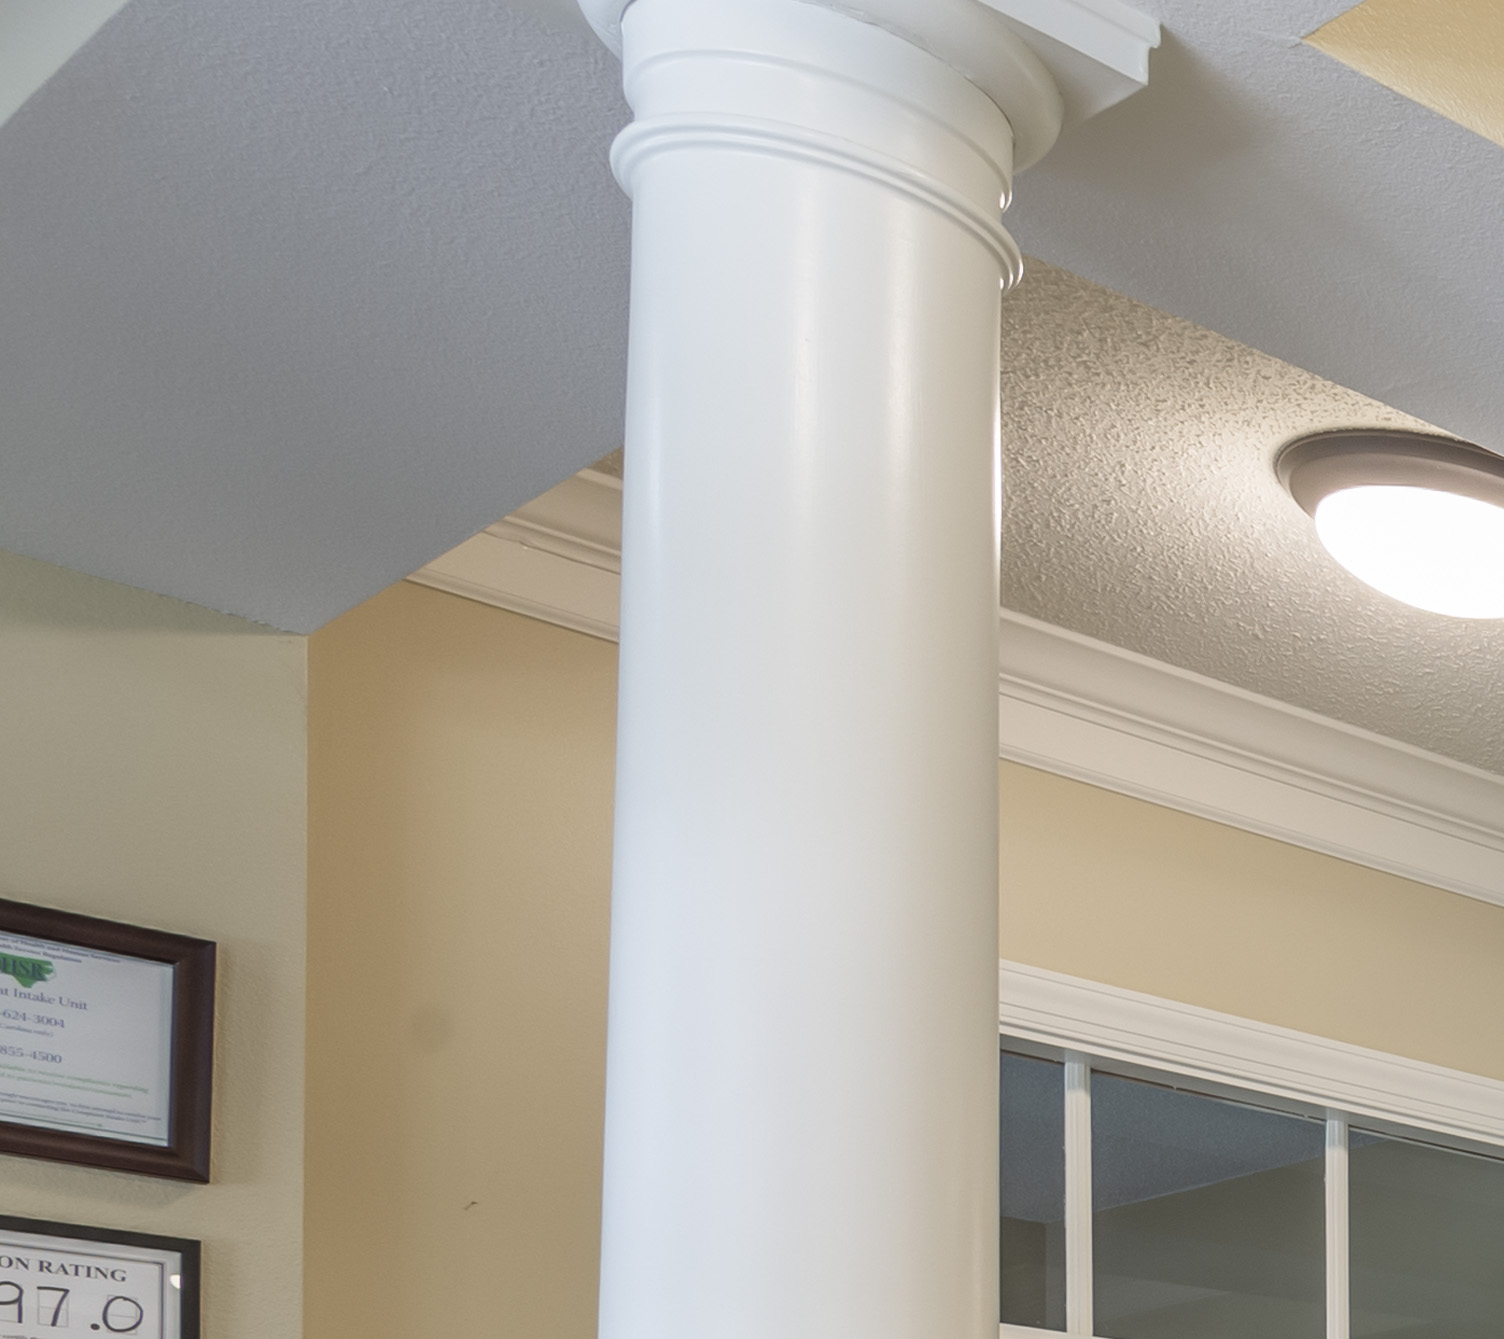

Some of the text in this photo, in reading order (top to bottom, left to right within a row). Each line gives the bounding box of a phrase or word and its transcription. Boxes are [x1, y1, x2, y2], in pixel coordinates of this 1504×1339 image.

[13, 988, 88, 1011] Intake Unit
[38, 1259, 127, 1283] RATING
